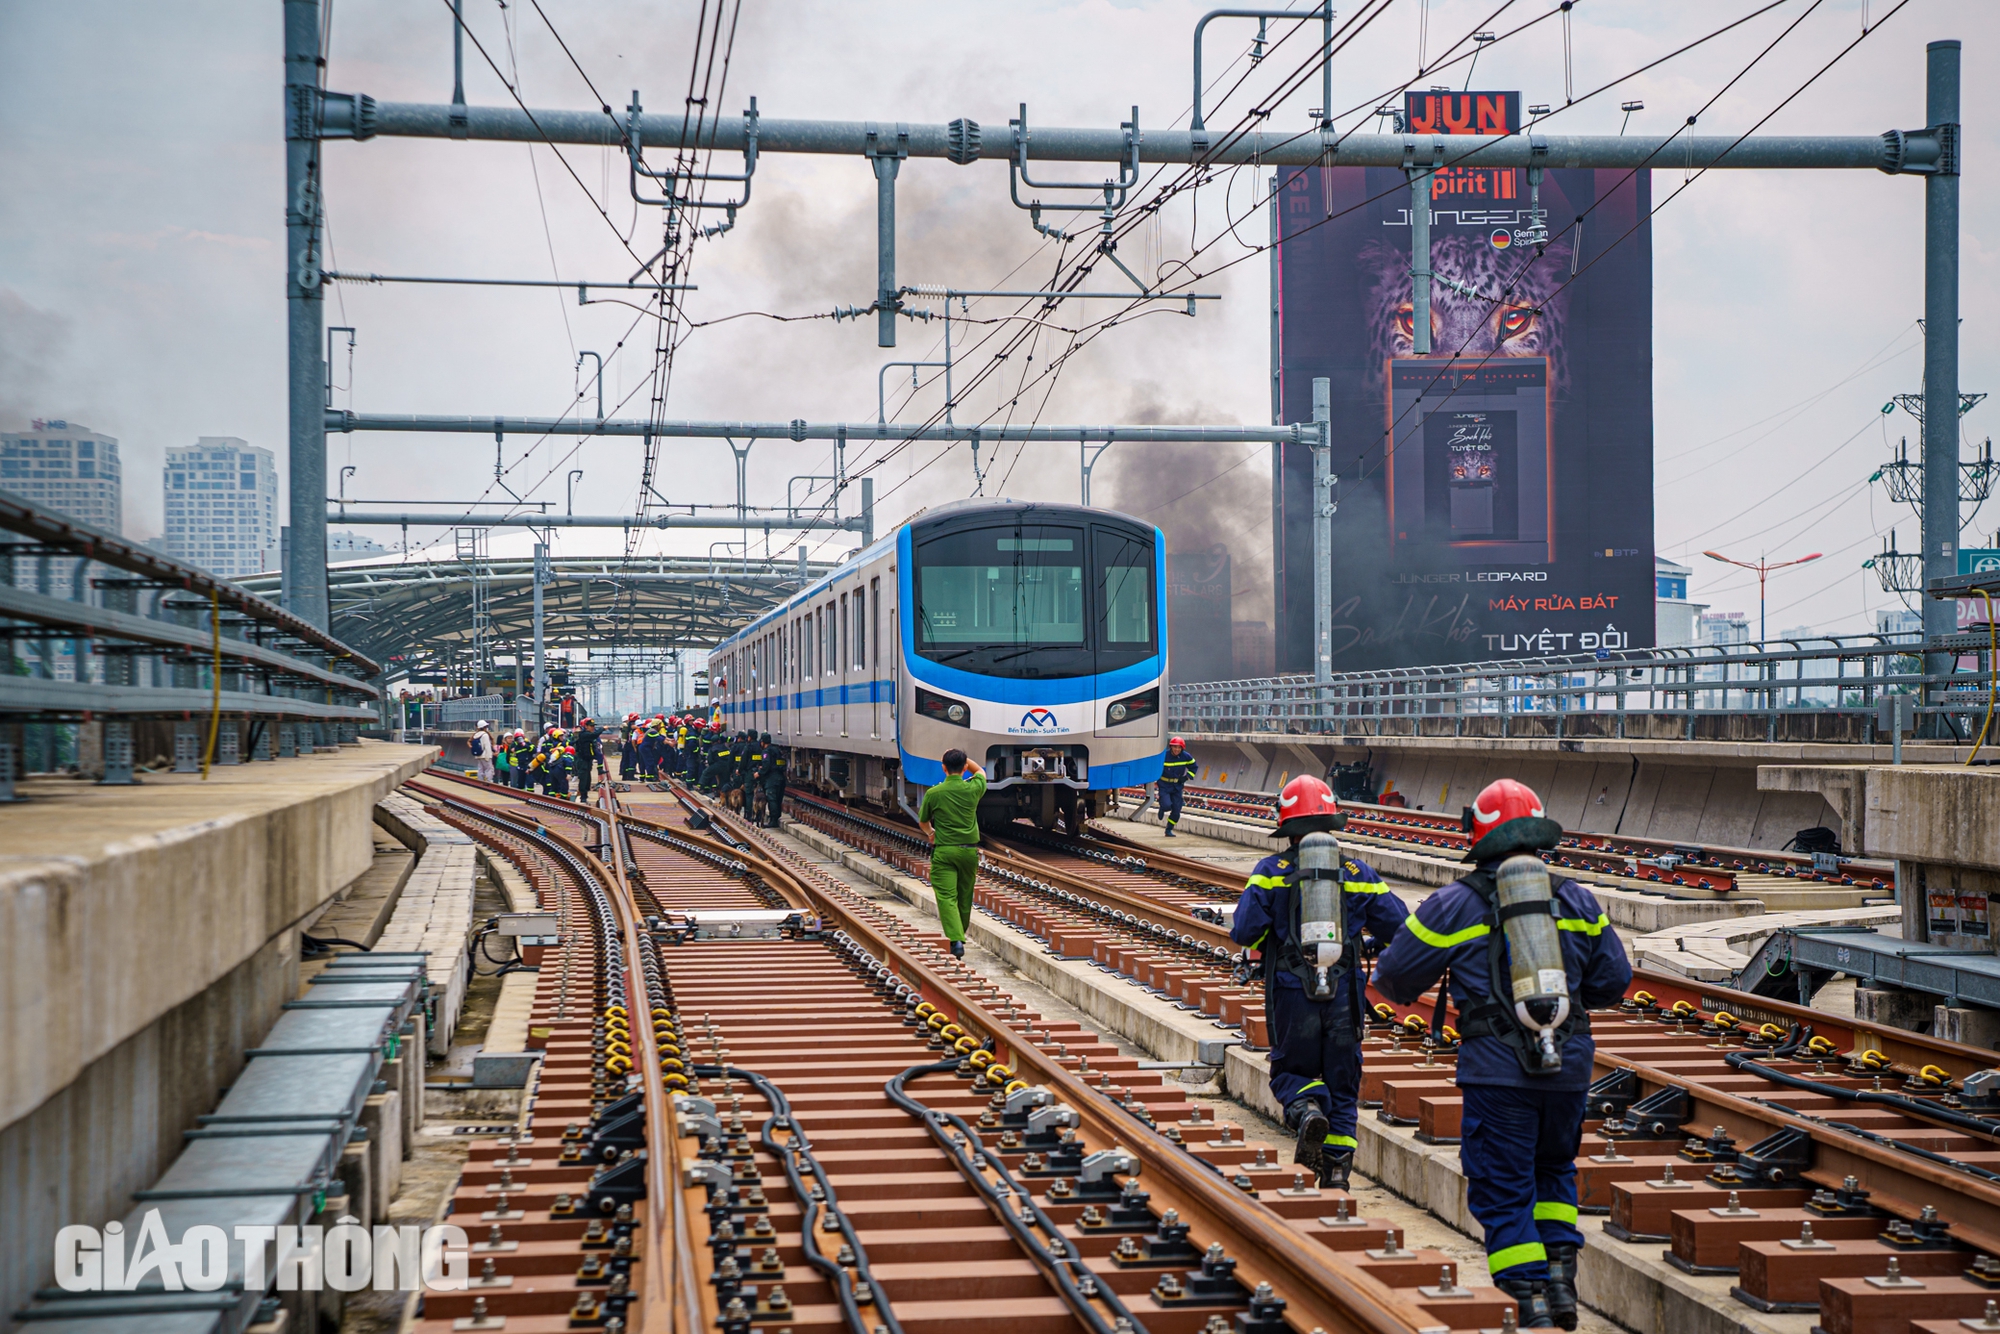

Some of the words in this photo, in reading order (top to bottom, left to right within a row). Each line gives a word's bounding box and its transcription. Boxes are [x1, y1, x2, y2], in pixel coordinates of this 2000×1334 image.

[1411, 95, 1507, 130] JUN
[1428, 171, 1487, 201] pirit
[1614, 549, 1639, 557] BTP
[1466, 571, 1547, 583] LEOPARD
[1489, 595, 1530, 611] MÁY
[1535, 594, 1576, 610] RỬA
[1580, 593, 1619, 610] BÁT
[1481, 627, 1574, 655] TUYỆT
[1579, 623, 1628, 650] ĐỐI
